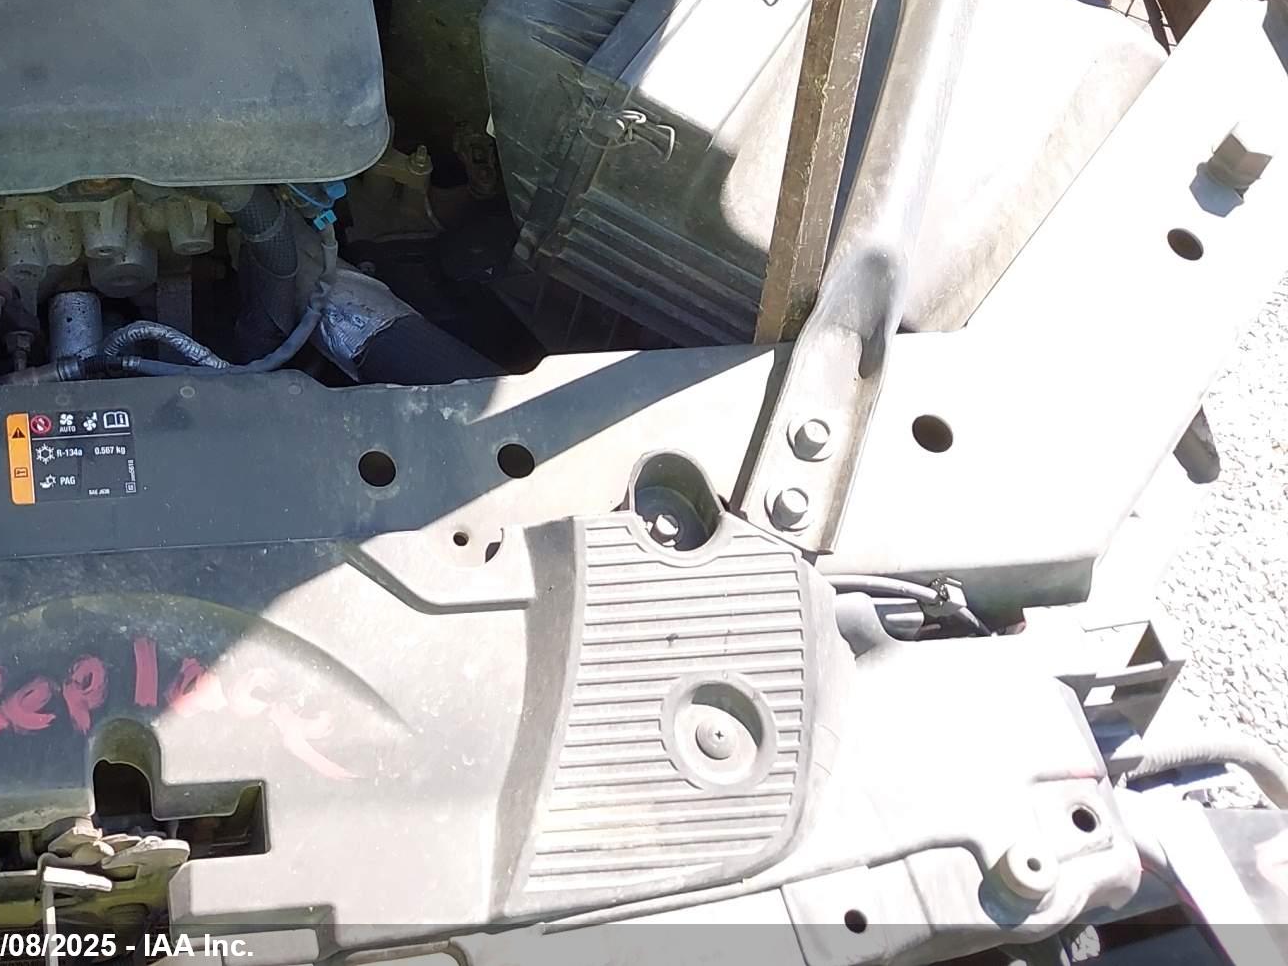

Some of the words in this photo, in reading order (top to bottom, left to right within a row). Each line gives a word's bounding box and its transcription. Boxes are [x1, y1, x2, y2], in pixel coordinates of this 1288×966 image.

[59, 425, 76, 433] AUTO
[56, 448, 83, 458] R-134a
[116, 445, 126, 455] kg
[60, 476, 76, 486] PAG
